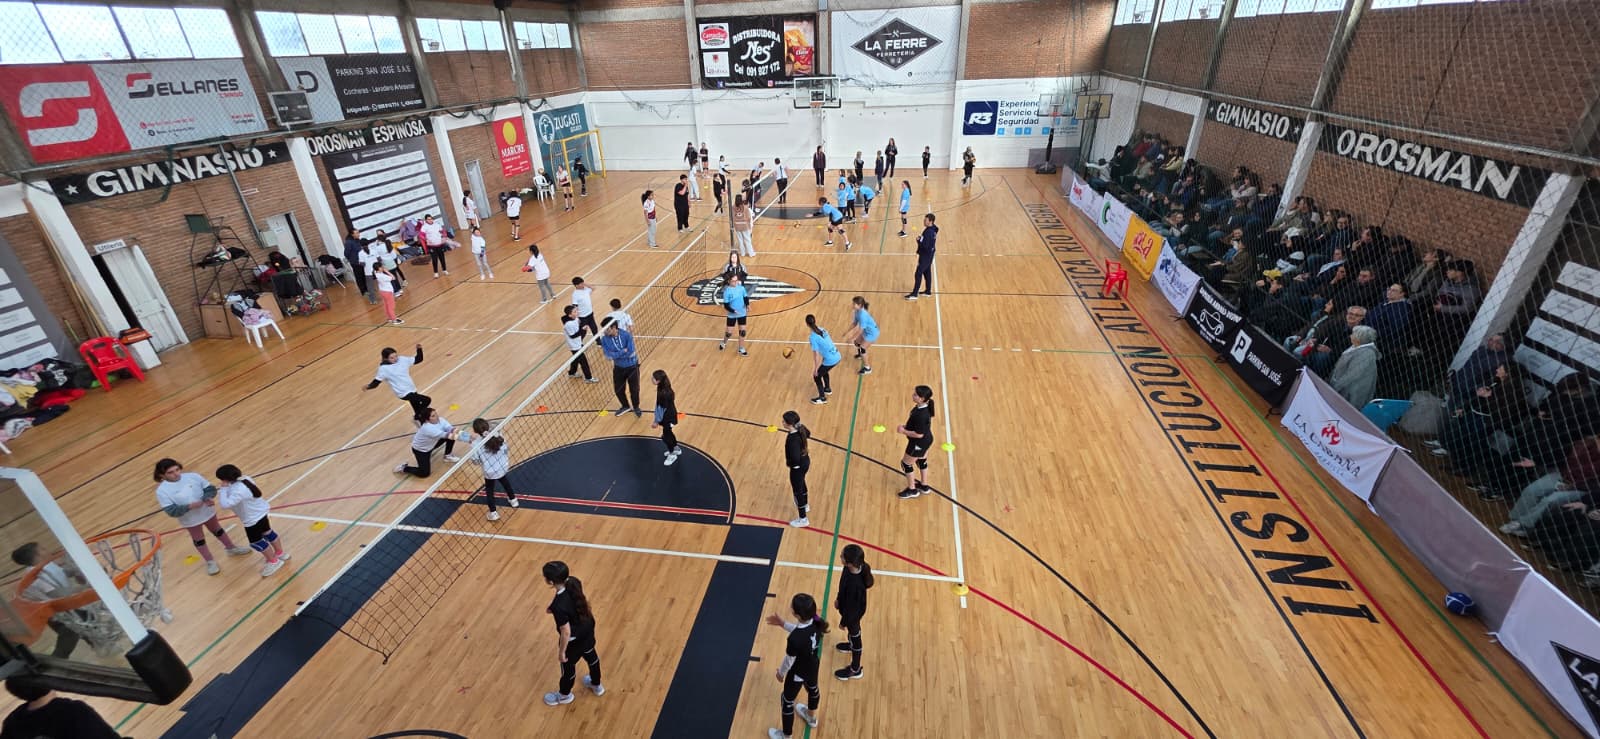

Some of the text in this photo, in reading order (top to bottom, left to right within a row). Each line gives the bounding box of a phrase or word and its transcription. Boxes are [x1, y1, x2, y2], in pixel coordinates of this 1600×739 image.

[732, 28, 781, 44] DISTRIBUIDORA
[865, 38, 927, 51] LA FERRE
[366, 66, 378, 74] SAN
[734, 63, 744, 75] Cel
[747, 66, 757, 76] 091
[758, 66, 768, 75] 927
[770, 61, 780, 73] 172
[126, 72, 239, 99] SELLANES
[999, 109, 1031, 117] Servicio
[1000, 100, 1040, 109] Experienc
[554, 112, 581, 130] ZUGASTI
[969, 112, 993, 125] R3
[998, 118, 1039, 127] Seguridad
[1216, 102, 1290, 138] GIMNASIO
[306, 129, 367, 156] OROSMAN
[371, 120, 427, 144] ESPINOSA
[87, 147, 264, 197] GIMNASIO
[1336, 128, 1520, 200] OROSMAN
[1025, 203, 1067, 230] NEGRO
[1045, 234, 1085, 252] RIO
[1061, 259, 1150, 335] ATLETICA
[1234, 335, 1246, 352] P
[1246, 351, 1262, 370] PARKING
[1260, 364, 1271, 377] SAN
[1293, 414, 1306, 433] LA
[1117, 345, 1379, 624] INSTITUCION
[1569, 657, 1599, 690] LA
